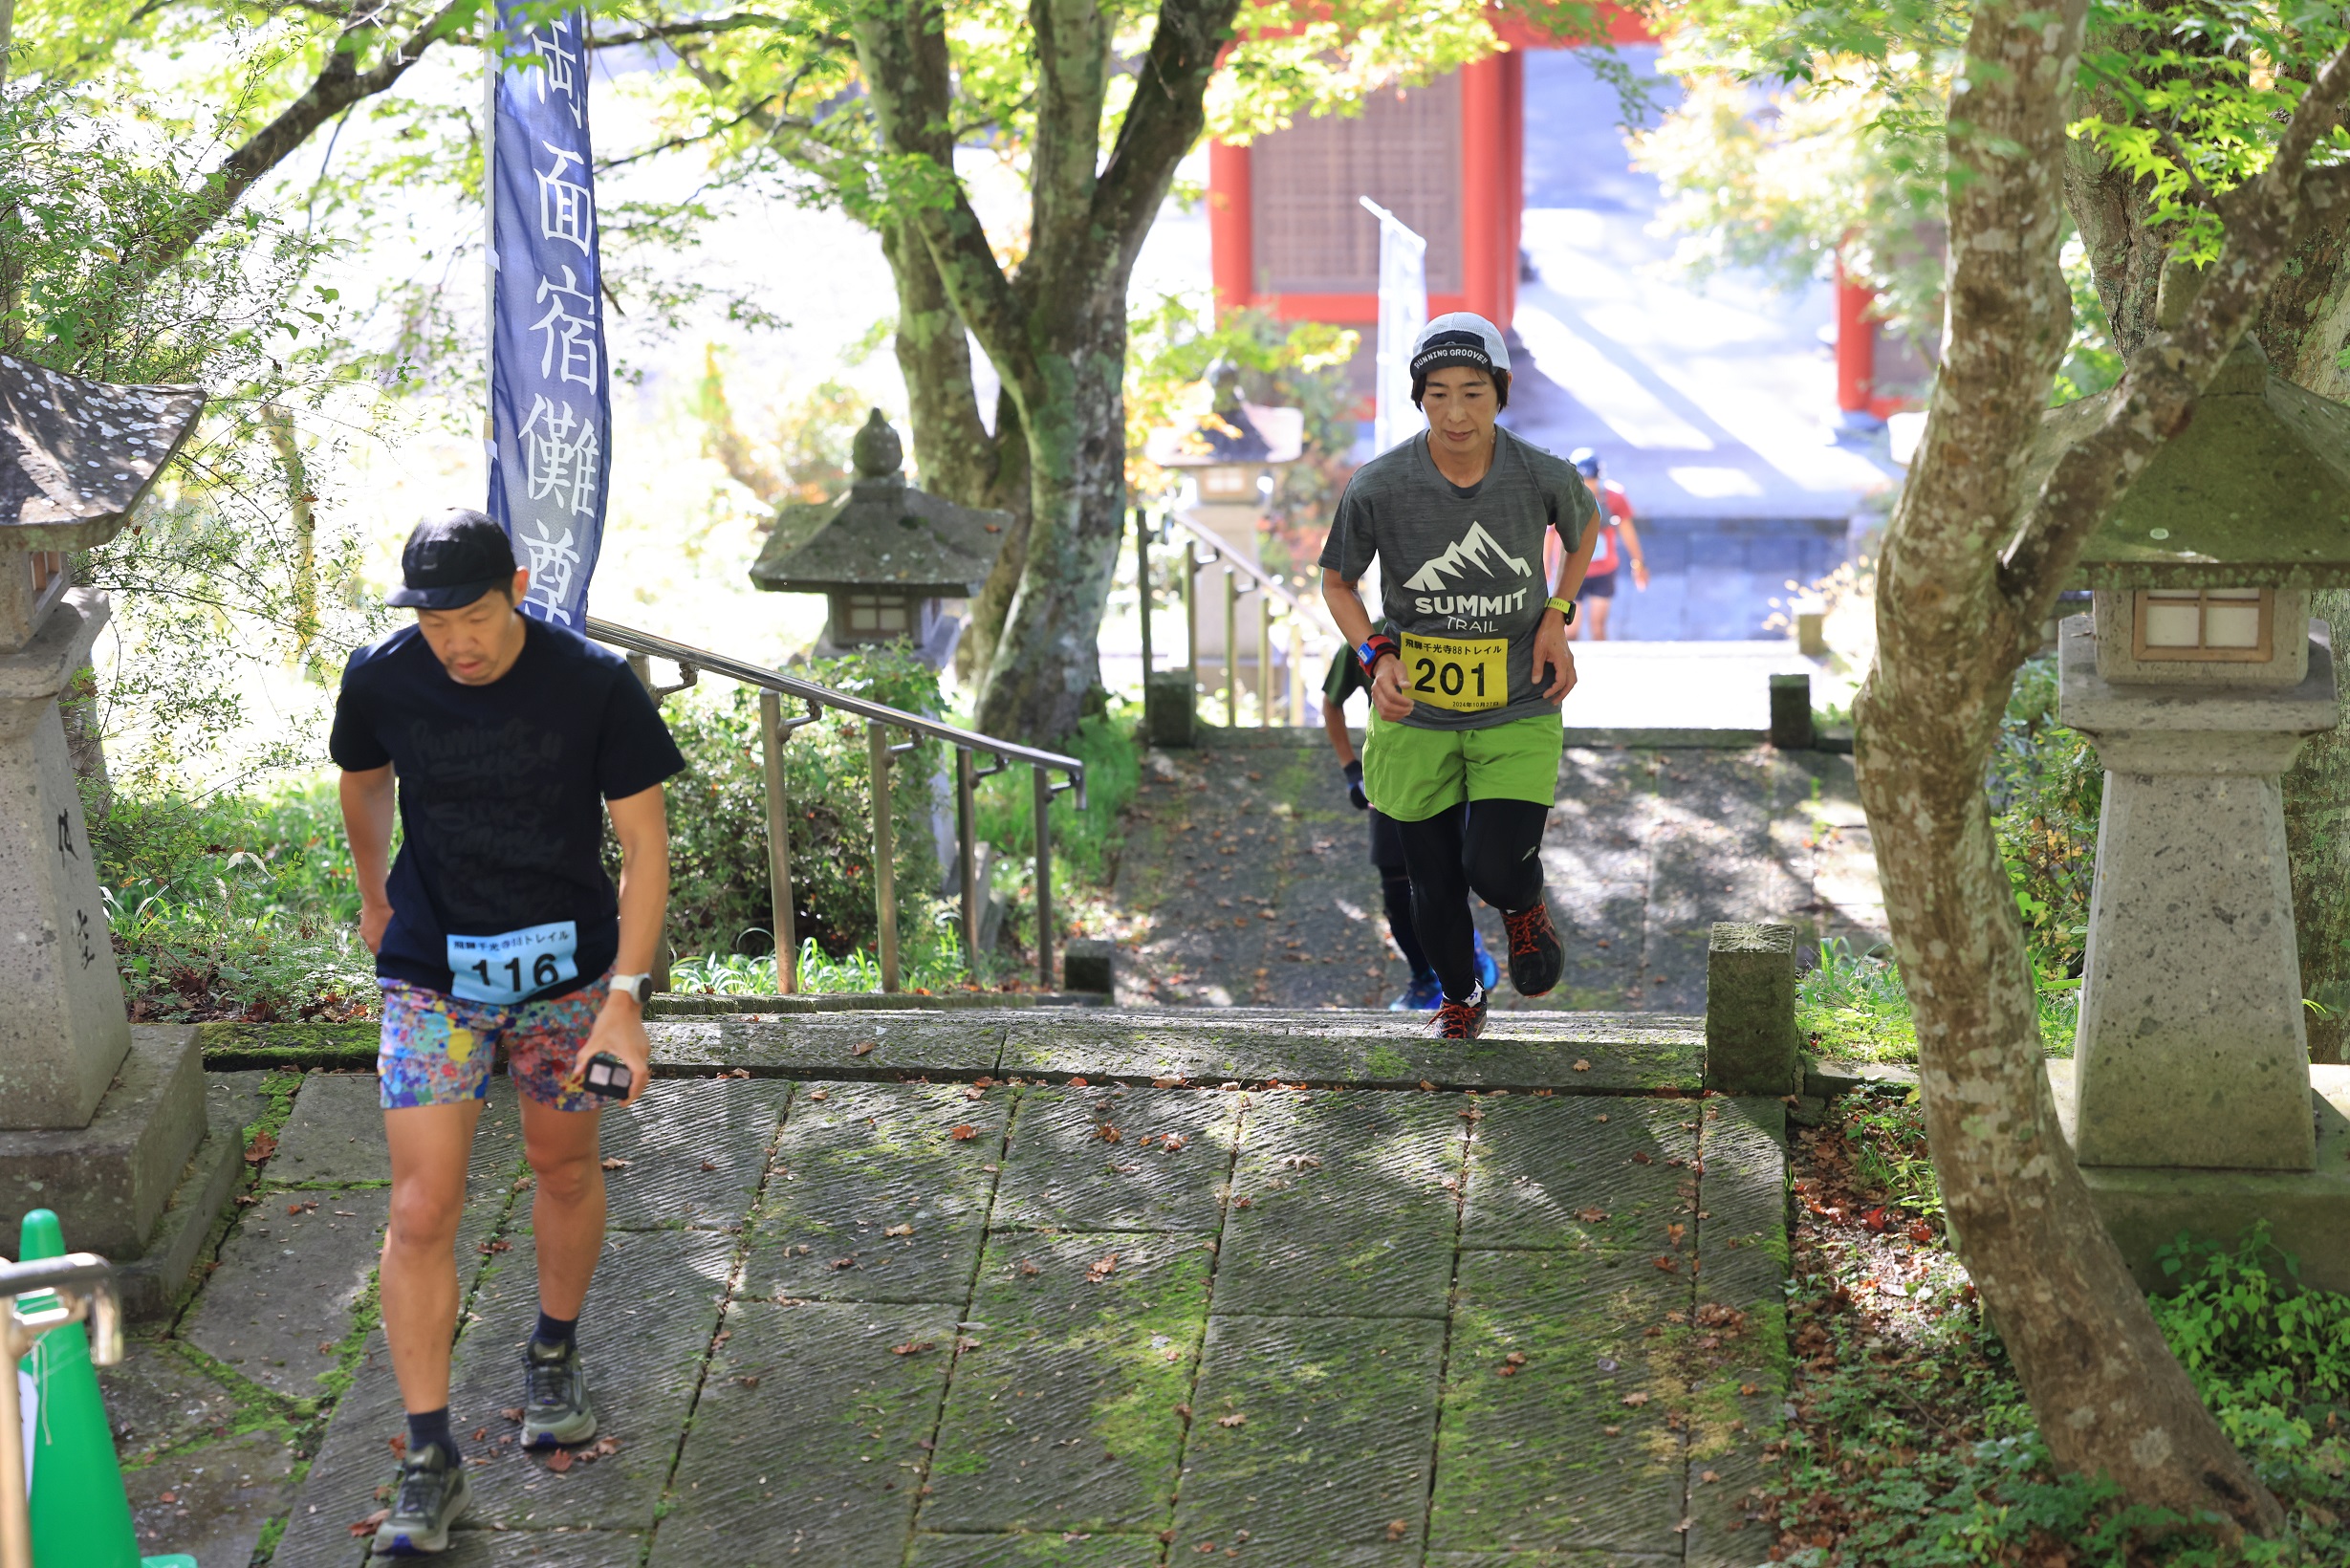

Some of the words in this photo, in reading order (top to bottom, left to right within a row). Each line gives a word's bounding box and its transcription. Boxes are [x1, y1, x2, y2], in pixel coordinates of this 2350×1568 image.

[1414, 349, 1448, 369] RUNNING
[1415, 587, 1527, 618] SUMMIT
[1447, 615, 1499, 634] TRAIL
[1414, 657, 1485, 697] 201
[471, 953, 559, 992] 116
